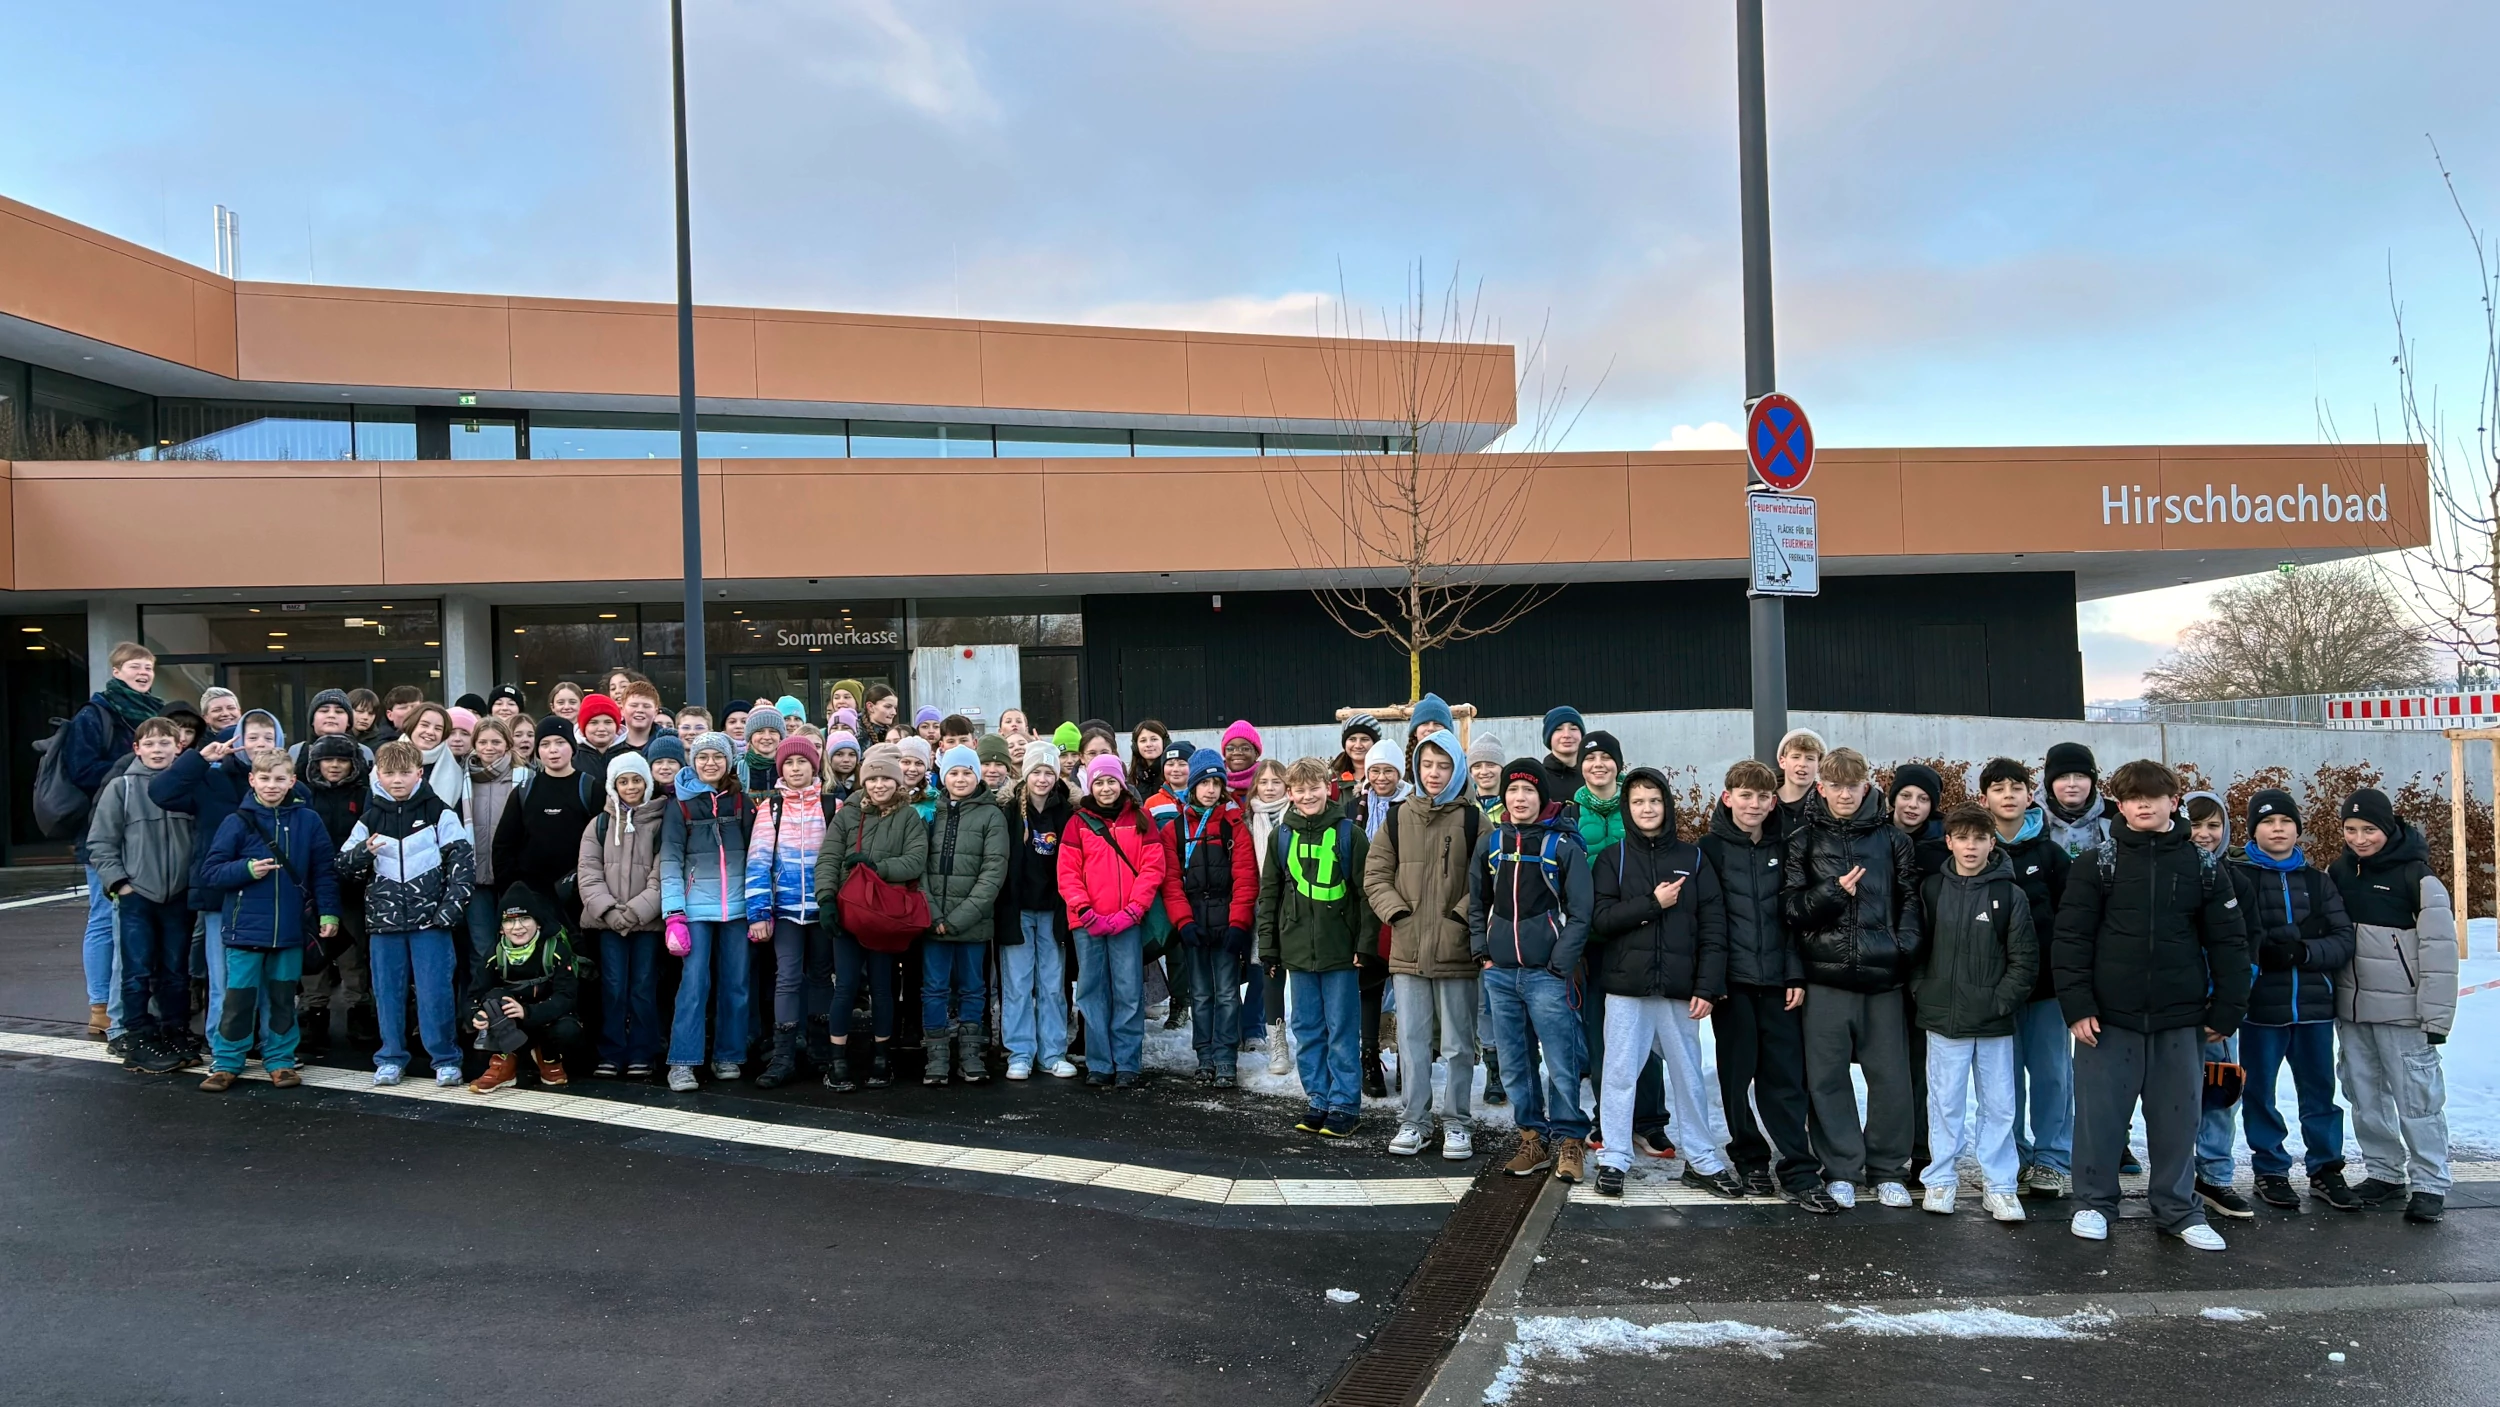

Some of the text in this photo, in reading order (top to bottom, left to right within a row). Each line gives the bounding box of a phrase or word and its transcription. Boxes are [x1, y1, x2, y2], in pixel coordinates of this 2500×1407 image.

[1753, 500, 1812, 515] Feuerwehrzufahrt
[2102, 483, 2388, 524] Hirschbachbad
[1777, 524, 1794, 534] FLÄCHE
[1796, 525, 1804, 535] FÜR
[1782, 538, 1814, 549] FEUERWEHR
[1789, 553, 1814, 562] FREIHALTEN
[777, 628, 898, 646] Sommerkasse
